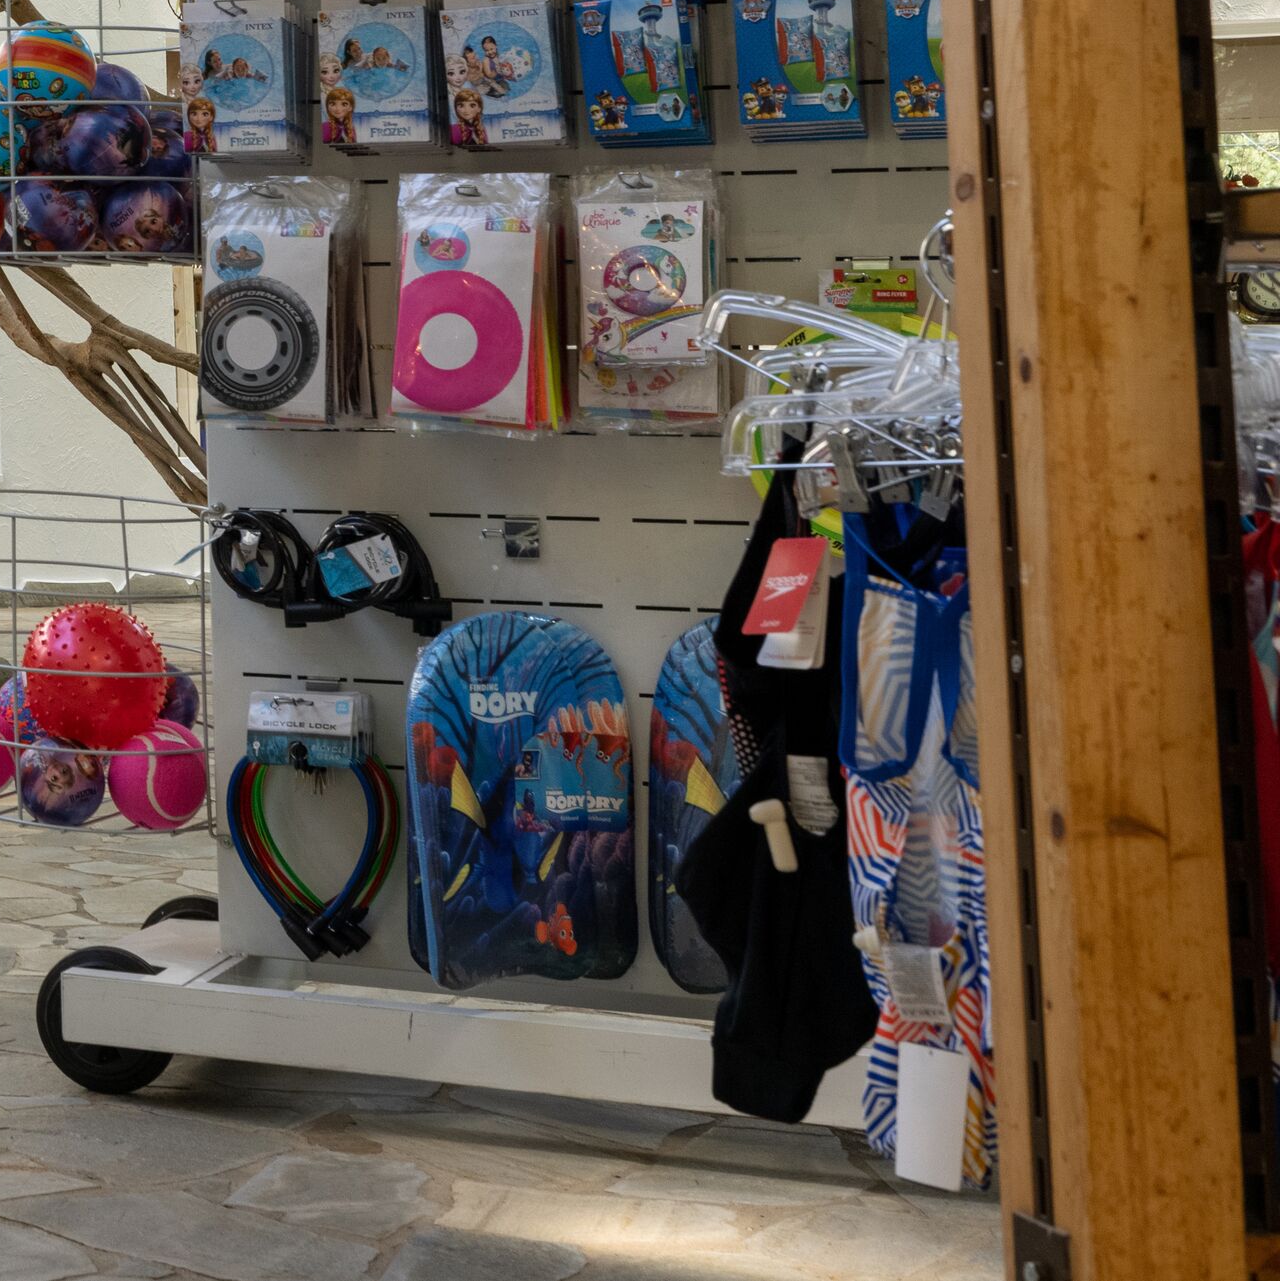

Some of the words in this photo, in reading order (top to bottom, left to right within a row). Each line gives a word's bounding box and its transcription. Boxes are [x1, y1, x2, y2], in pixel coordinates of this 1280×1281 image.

[386, 11, 416, 19] INTEX
[509, 9, 538, 18] INTEX
[245, 23, 274, 31] INTEX
[370, 126, 412, 138] FROZEN
[502, 127, 544, 139] FROZEN
[230, 136, 270, 147] FROZEN
[485, 219, 530, 233] INTEX
[824, 287, 856, 297] Summer
[217, 290, 303, 324] PERFORMANCE
[469, 683, 499, 692] FINDING
[469, 691, 538, 716] DORY
[263, 720, 306, 728] BICYCLE
[309, 722, 337, 731] LOCK
[545, 795, 586, 809] DORY
